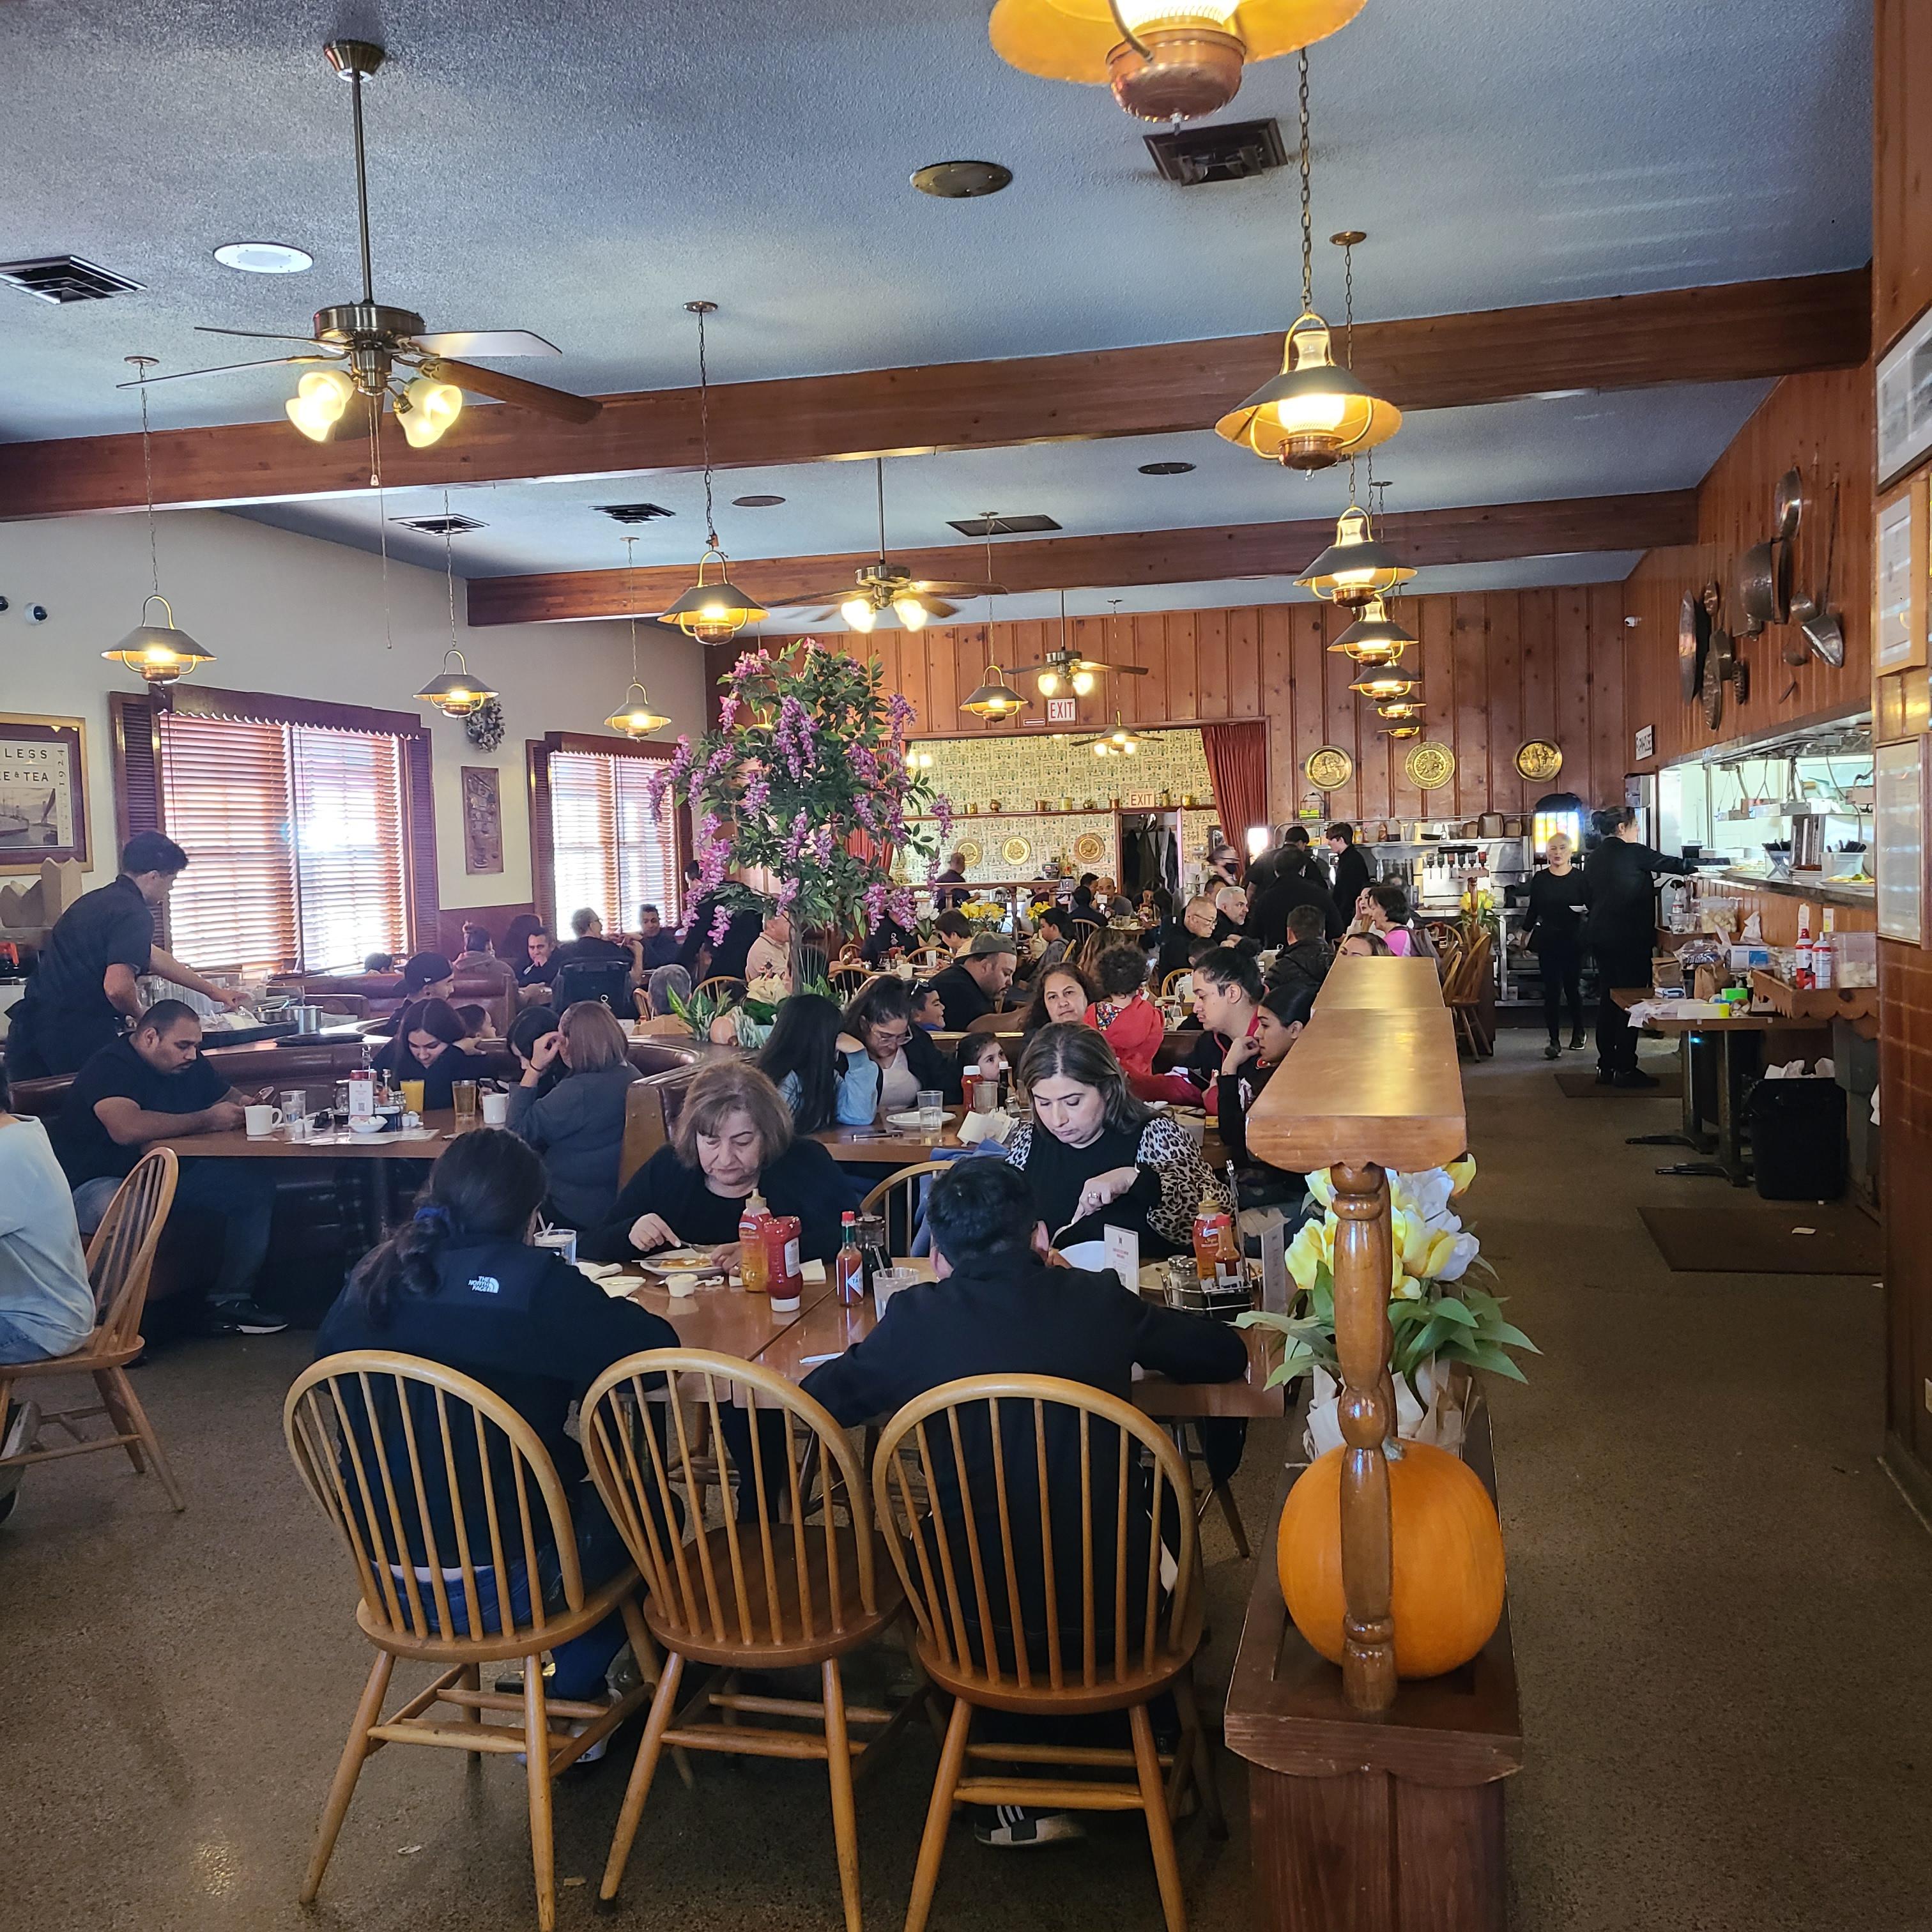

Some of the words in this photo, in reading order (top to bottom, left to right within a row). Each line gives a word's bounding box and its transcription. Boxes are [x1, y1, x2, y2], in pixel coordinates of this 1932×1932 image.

[1050, 702, 1073, 719] EXIT
[4, 747, 48, 759] LESS
[57, 749, 66, 786] 1924
[23, 771, 49, 782] TEA
[1131, 793, 1153, 806] EXIT
[468, 1279, 489, 1287] NORTH
